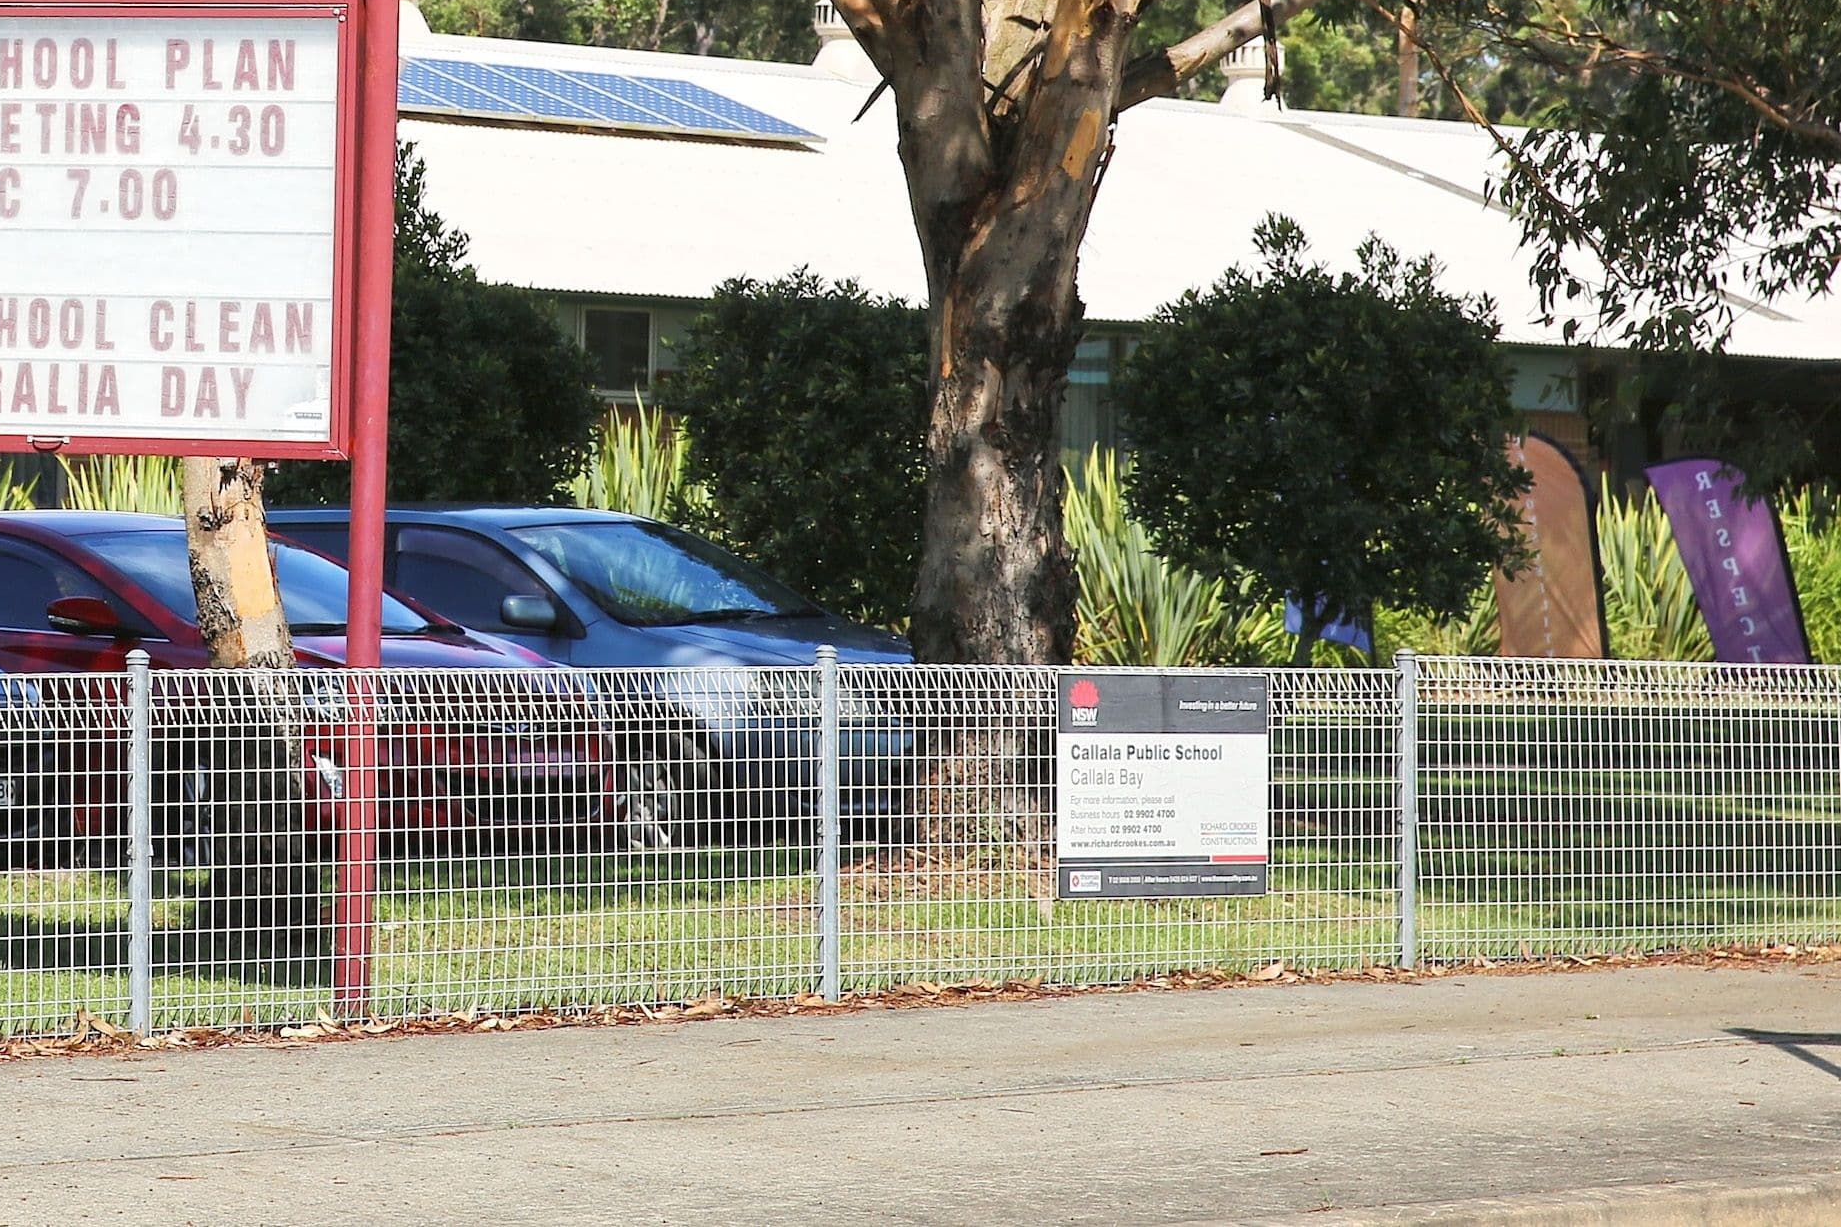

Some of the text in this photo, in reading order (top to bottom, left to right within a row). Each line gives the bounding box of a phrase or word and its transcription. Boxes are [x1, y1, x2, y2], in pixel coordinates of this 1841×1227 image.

[166, 38, 297, 92] PLAN
[178, 104, 287, 157] 4.30
[66, 167, 179, 221] 7.00
[149, 300, 314, 354] CLEAN
[161, 365, 255, 420] DAY
[1072, 707, 1098, 721] NSW
[1071, 744, 1223, 761] Callala Public School
[1070, 768, 1144, 789] Callala Bay
[1083, 796, 1100, 804] more
[1141, 795, 1162, 806] please
[1164, 795, 1175, 804] call
[1070, 809, 1176, 819] Business hours 02 9902 4700
[1070, 824, 1162, 834] After hours 02 9902 4700
[1200, 822, 1257, 831] RICHARD CROOKES
[1070, 838, 1176, 848] www.richardcrookes.com.au
[1200, 837, 1258, 846] CONSTRUCTIONS
